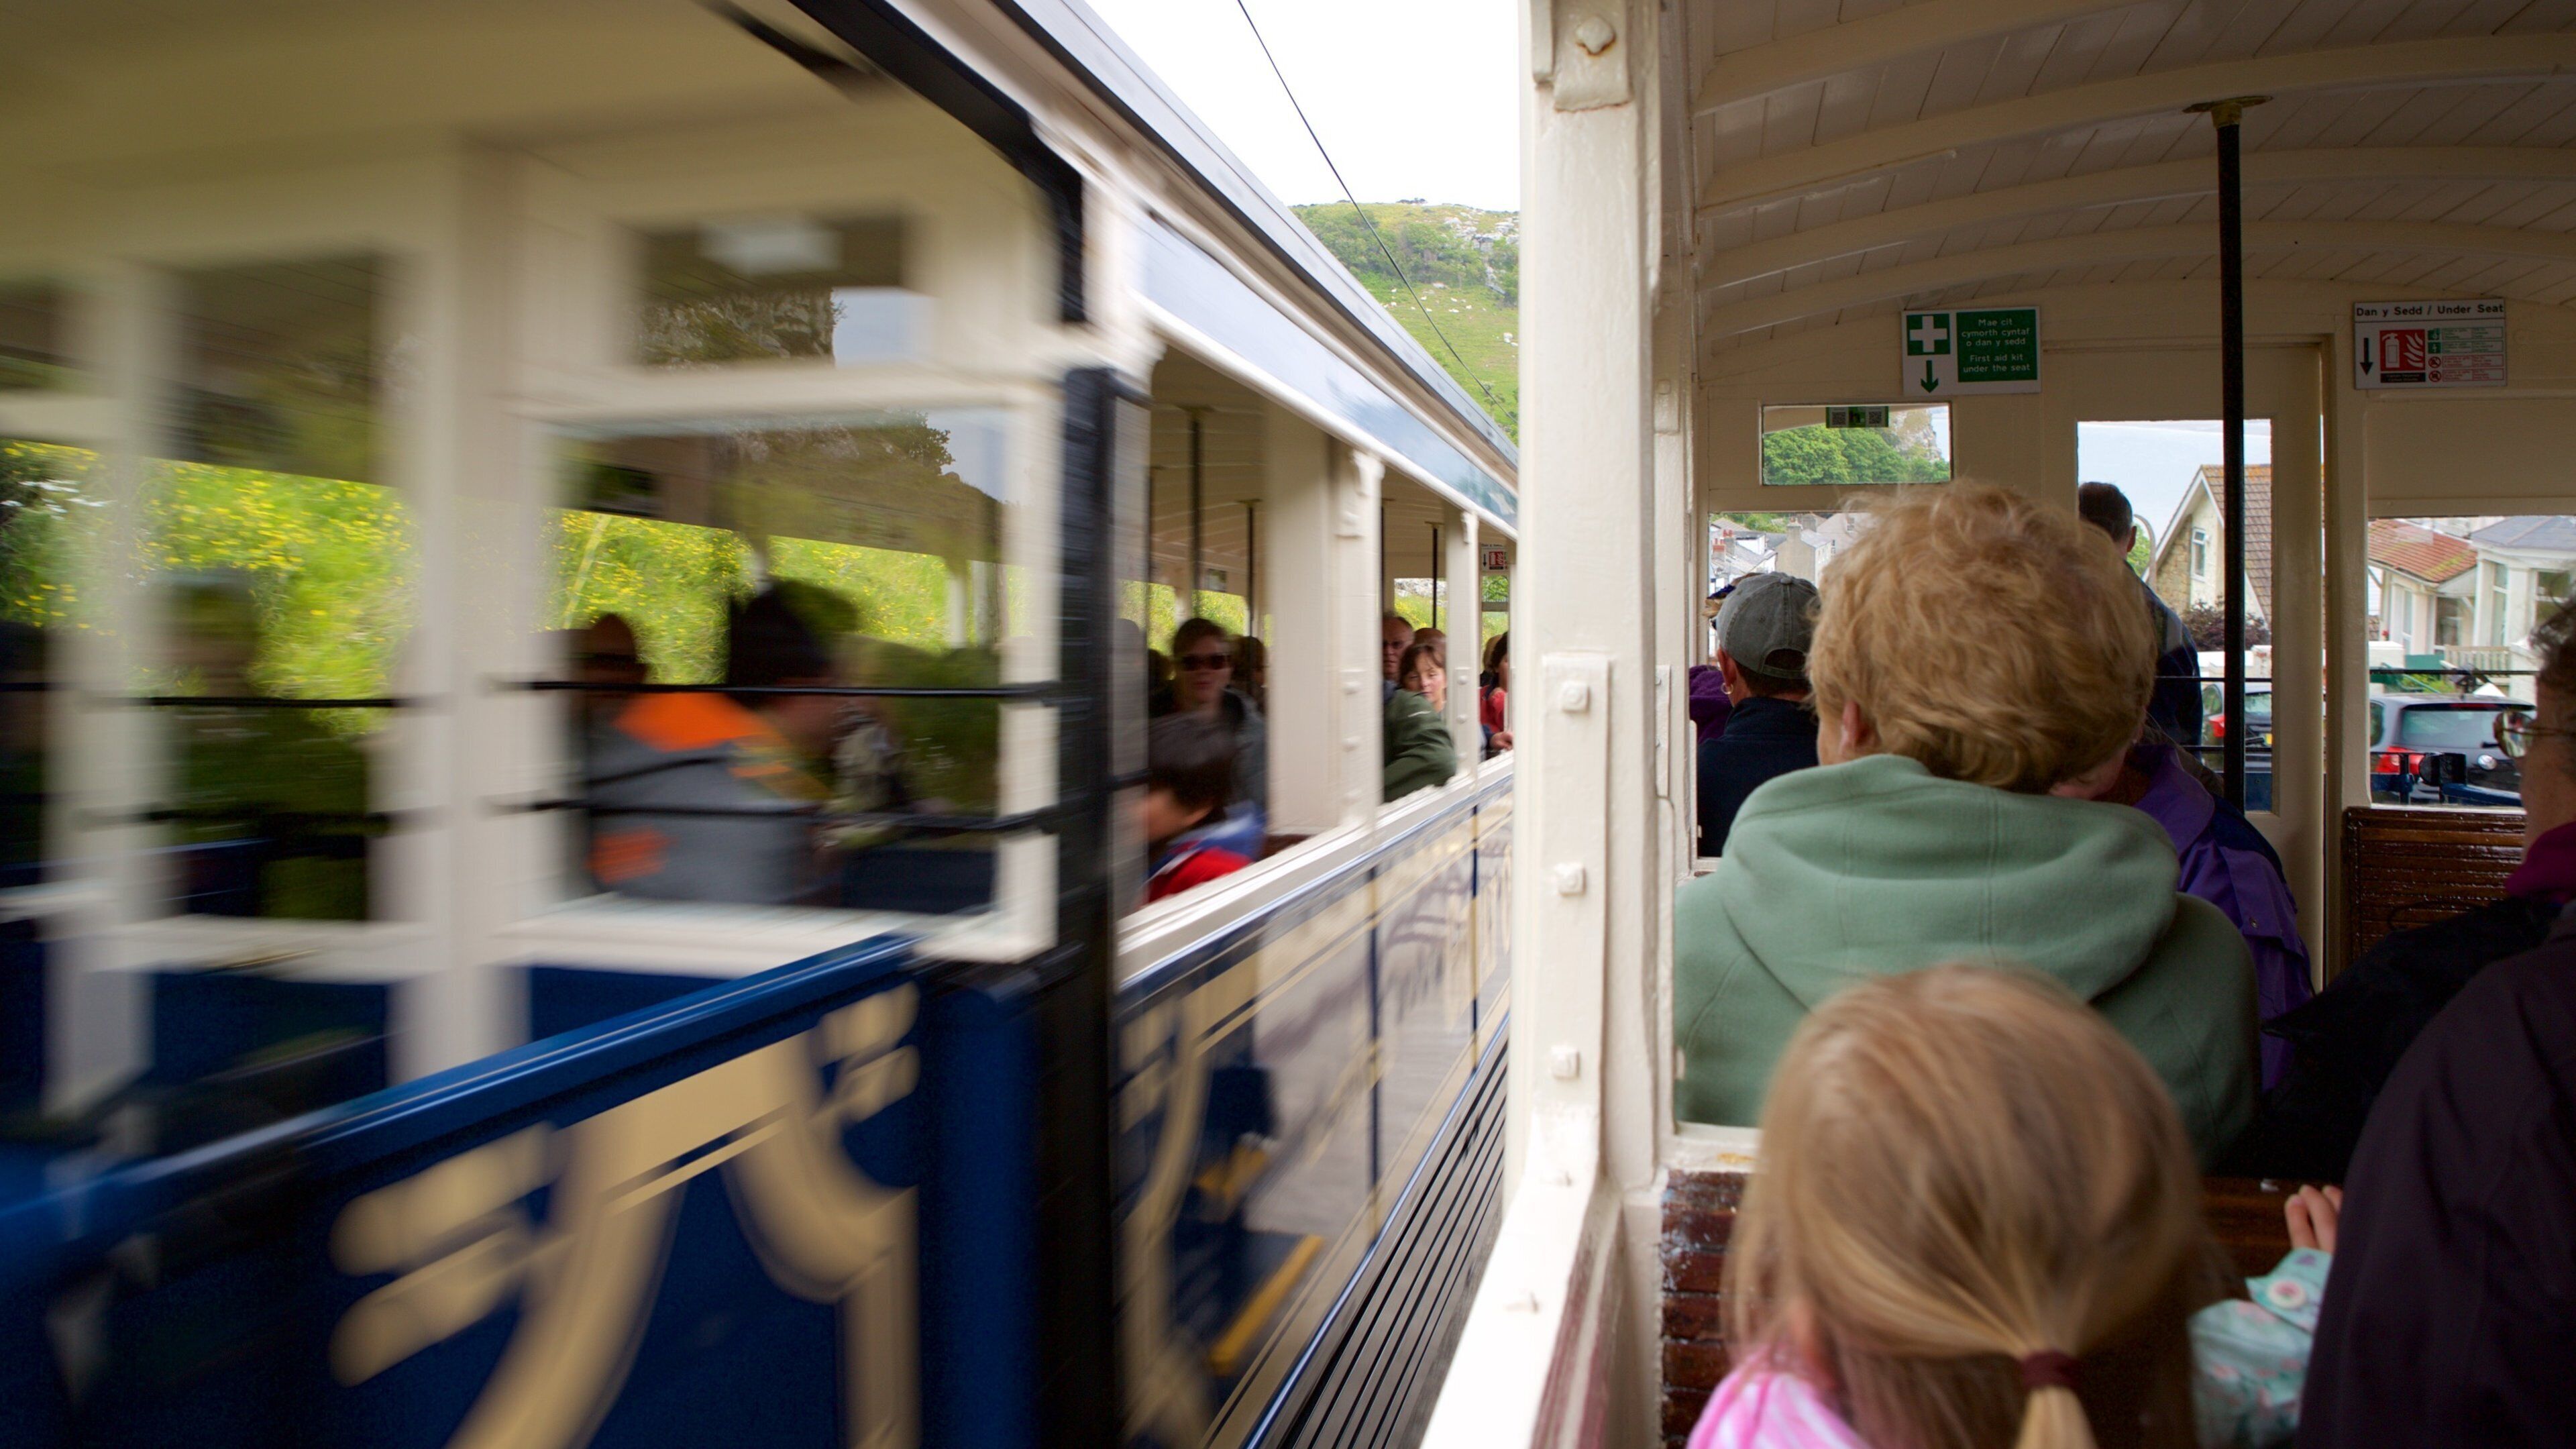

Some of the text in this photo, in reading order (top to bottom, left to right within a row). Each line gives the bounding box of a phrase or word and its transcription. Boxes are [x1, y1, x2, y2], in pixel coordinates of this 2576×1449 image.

[2356, 307, 2377, 316] Dan
[2382, 309, 2388, 317] y
[2394, 306, 2422, 315] Sedd
[2437, 305, 2471, 314] Under
[2477, 304, 2504, 313] Seat
[1978, 319, 1998, 327] Mae
[1962, 327, 2030, 338] cymorth cyntaf
[1970, 354, 1990, 362] First
[1994, 354, 2007, 362] aid
[1963, 363, 2030, 373] under the seat
